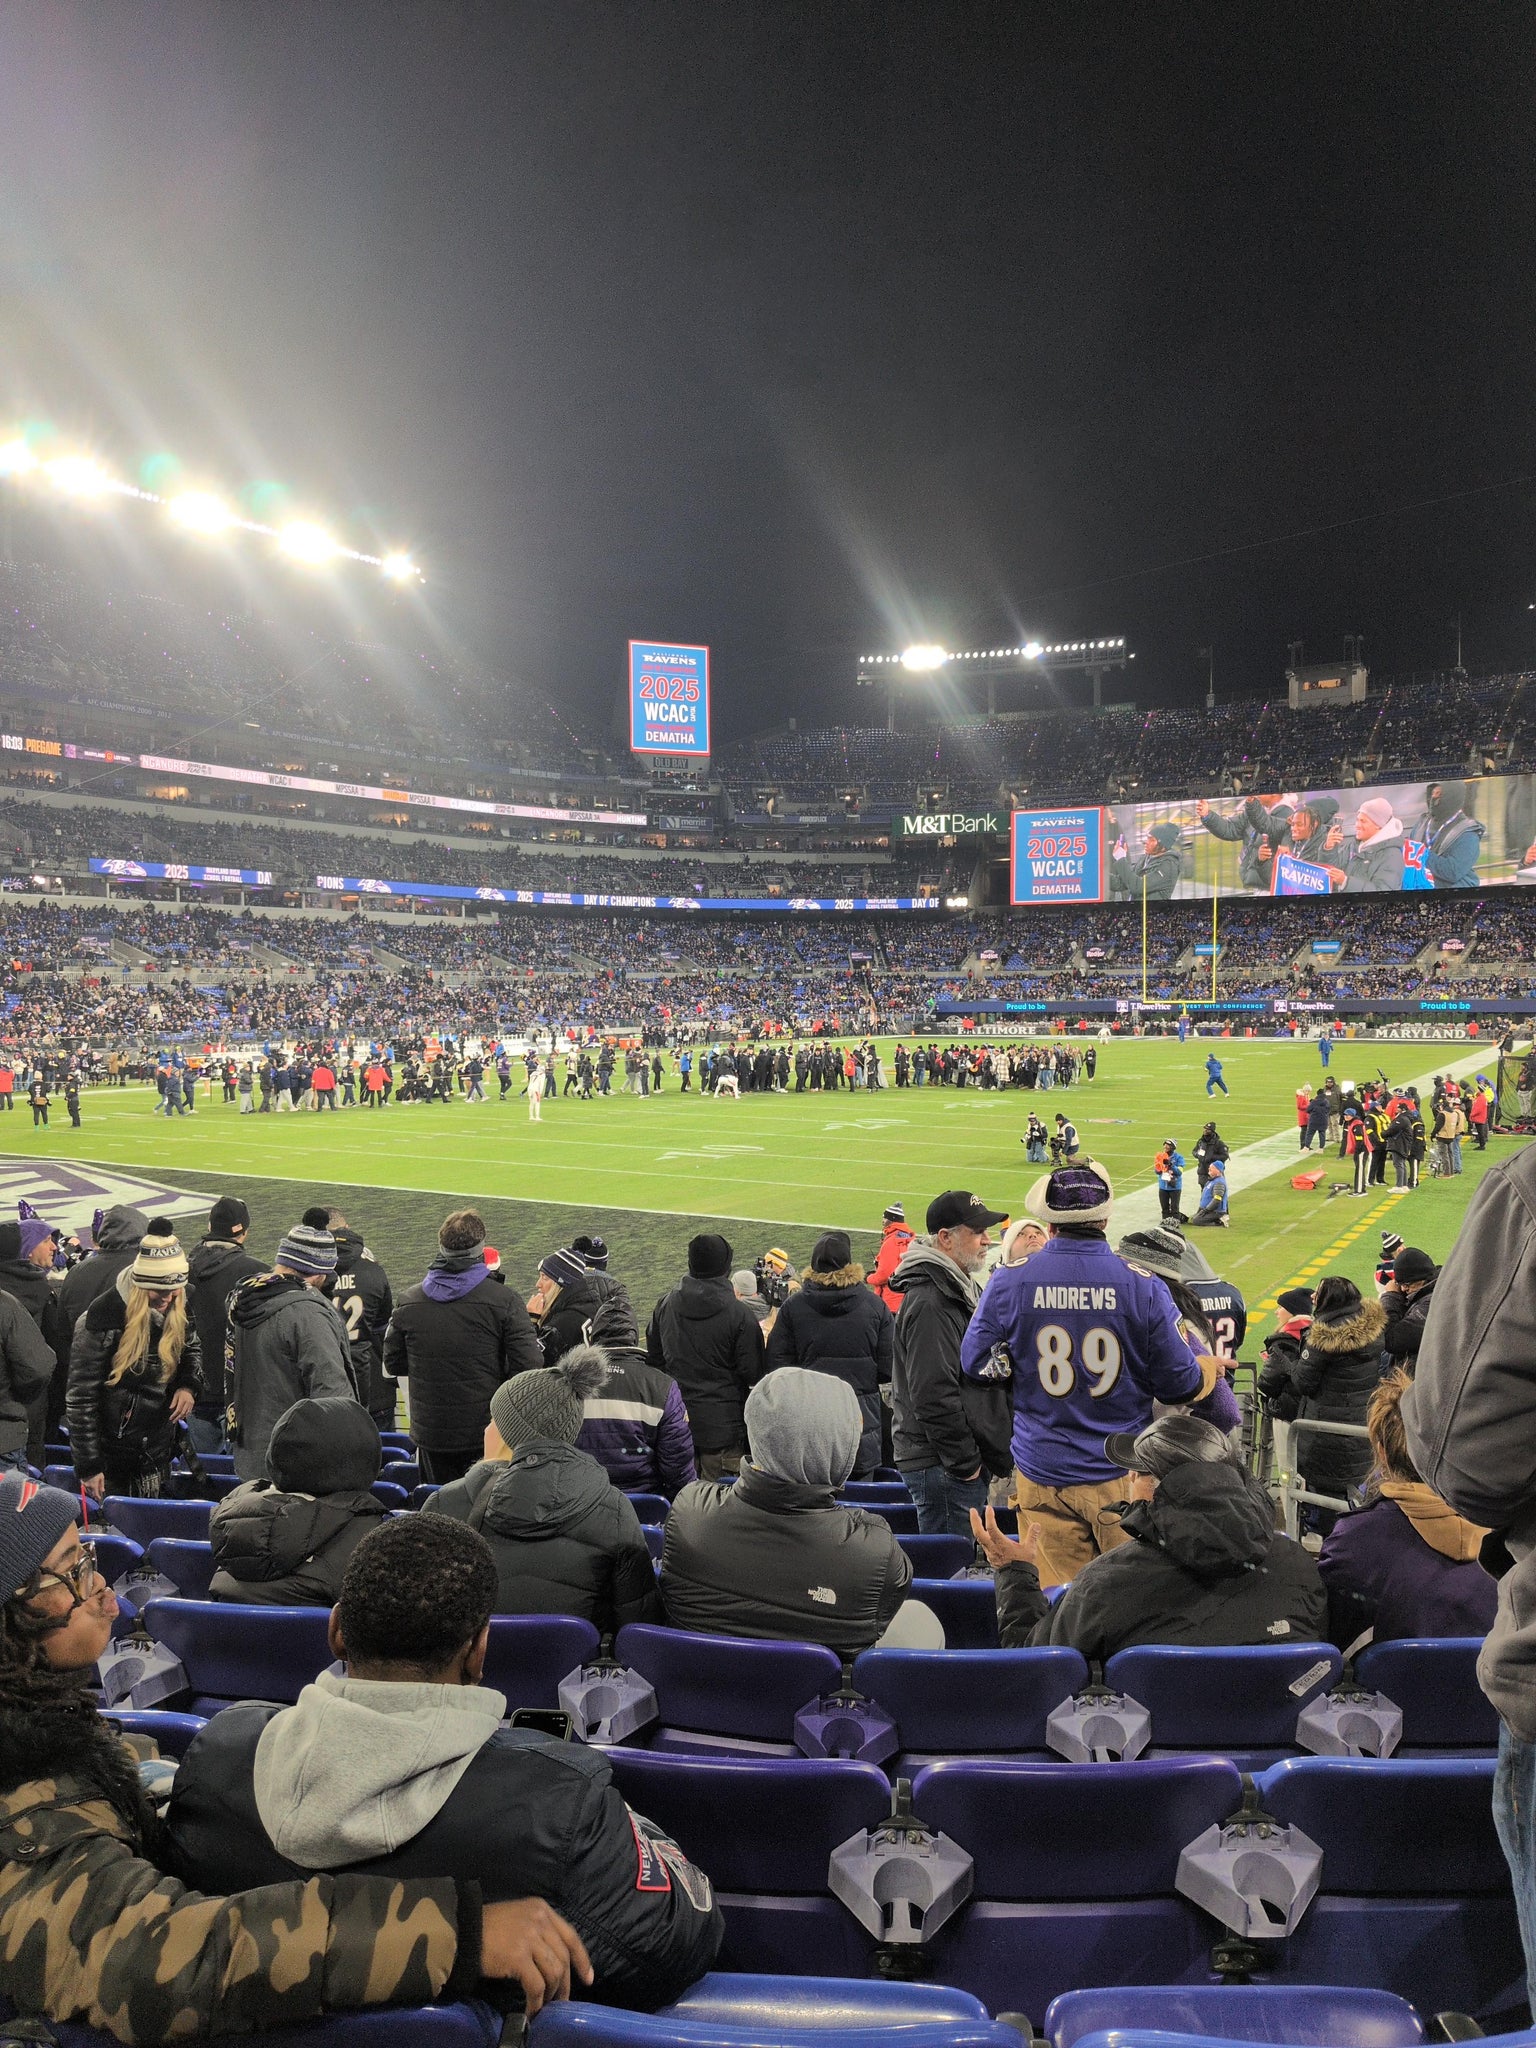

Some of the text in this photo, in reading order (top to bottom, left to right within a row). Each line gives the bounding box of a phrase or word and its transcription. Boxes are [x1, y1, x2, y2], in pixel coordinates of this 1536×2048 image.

[642, 655, 697, 665] RAVENS
[639, 676, 700, 701] 2025
[99, 701, 136, 712] CHAMPIONS
[644, 702, 689, 723] WCAC
[645, 731, 695, 744] DEMATHA
[1, 734, 62, 756] 16:03 PREGAME
[655, 758, 687, 769] OLD BAY
[268, 773, 288, 785] WCAC
[336, 783, 359, 796] MPSSAA
[409, 793, 431, 805] MPSSAA
[569, 811, 593, 821] MPSSAA
[616, 812, 647, 825] HUNTING
[1031, 818, 1085, 827] RAVENS
[903, 813, 997, 835] M&T Bank
[1027, 836, 1088, 859] 2025
[165, 864, 189, 879] 2025
[1032, 860, 1076, 877] WCAC
[316, 875, 345, 890] PIONS
[1281, 867, 1325, 891] RAVENS
[517, 889, 534, 902] 2025
[1032, 884, 1082, 895] DEMATHA
[583, 894, 656, 908] DAY OF CHAMPIONS
[834, 898, 854, 910] 2025
[911, 898, 926, 909] DAY
[929, 897, 940, 908] OF
[1420, 1002, 1471, 1010] Proud to be
[1375, 1029, 1466, 1039] MARYLAND
[1033, 1285, 1118, 1311] ANDREWS
[1200, 1296, 1232, 1312] BRADY
[1036, 1324, 1124, 1400] 89
[807, 1589, 826, 1598] NORTH
[812, 1594, 826, 1603] FACE
